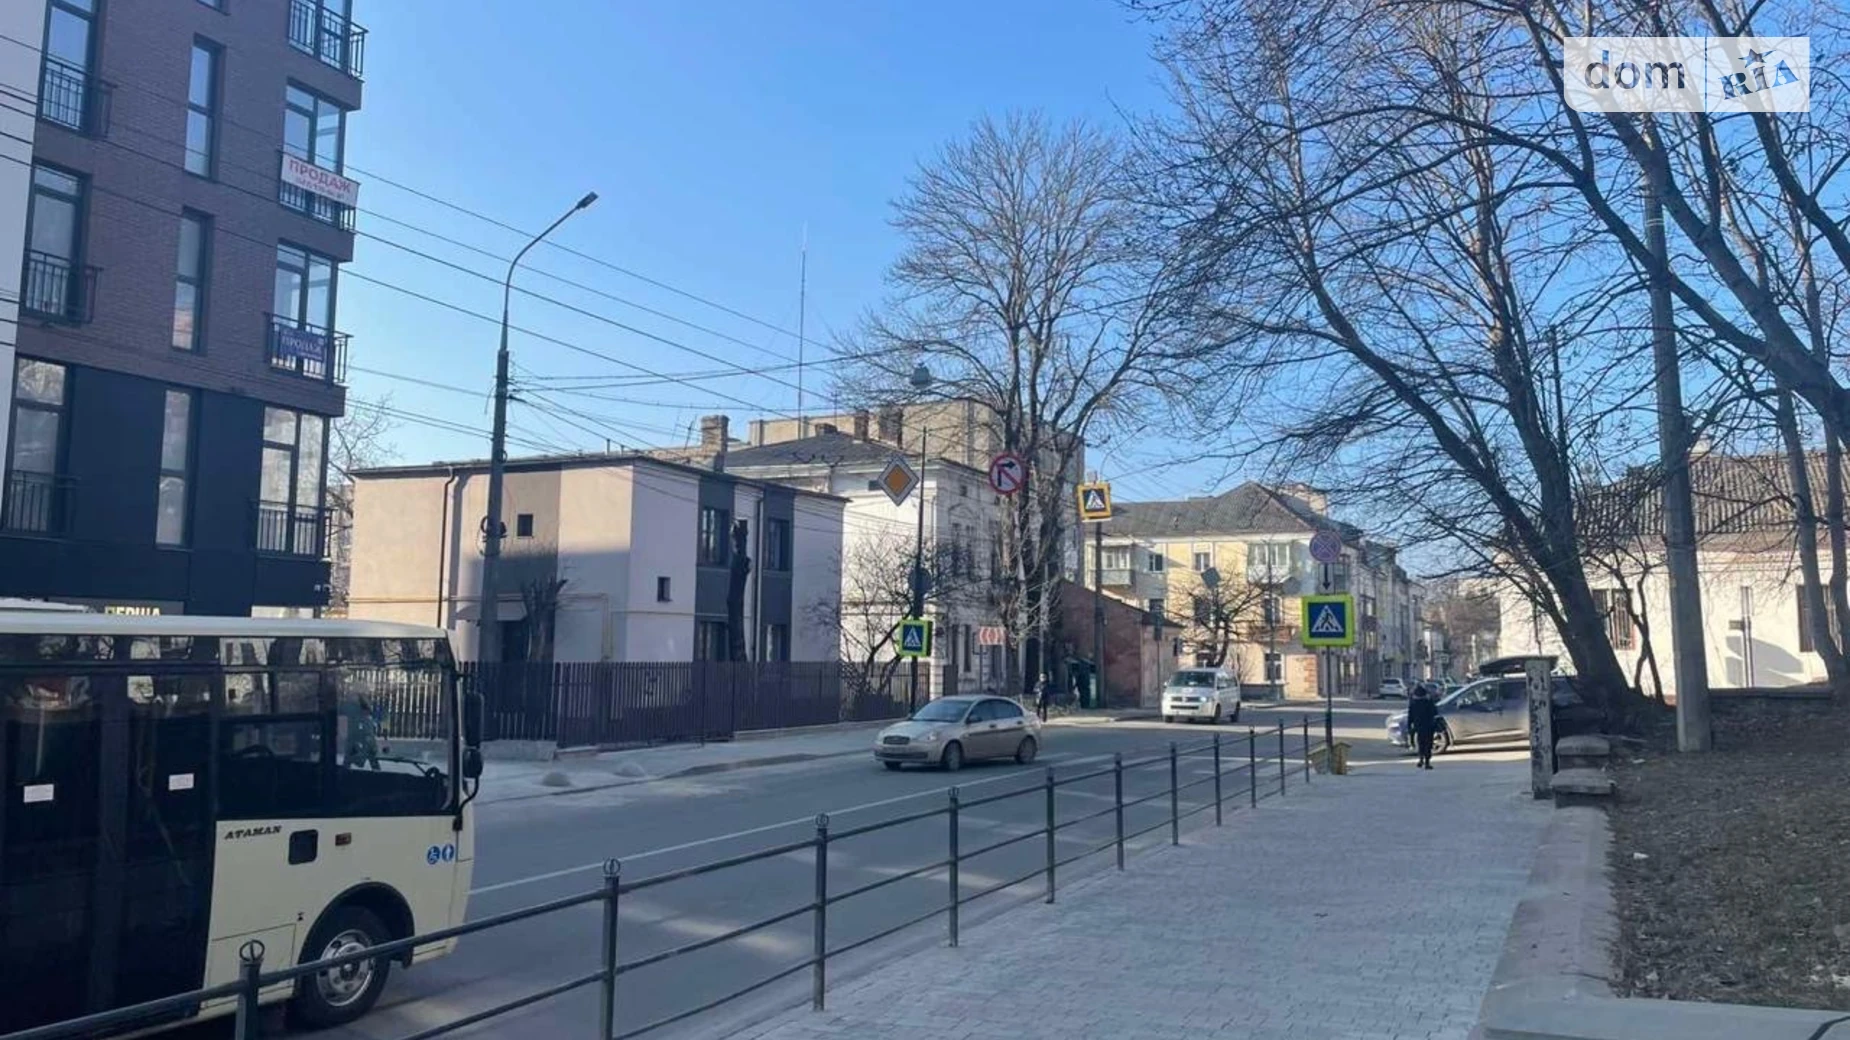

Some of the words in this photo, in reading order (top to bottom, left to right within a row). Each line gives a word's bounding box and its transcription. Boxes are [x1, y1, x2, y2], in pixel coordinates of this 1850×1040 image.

[289, 159, 352, 194] ПРОДАЖ
[281, 335, 322, 354] ПРОДАЖ
[224, 825, 282, 840] ATAMAN
